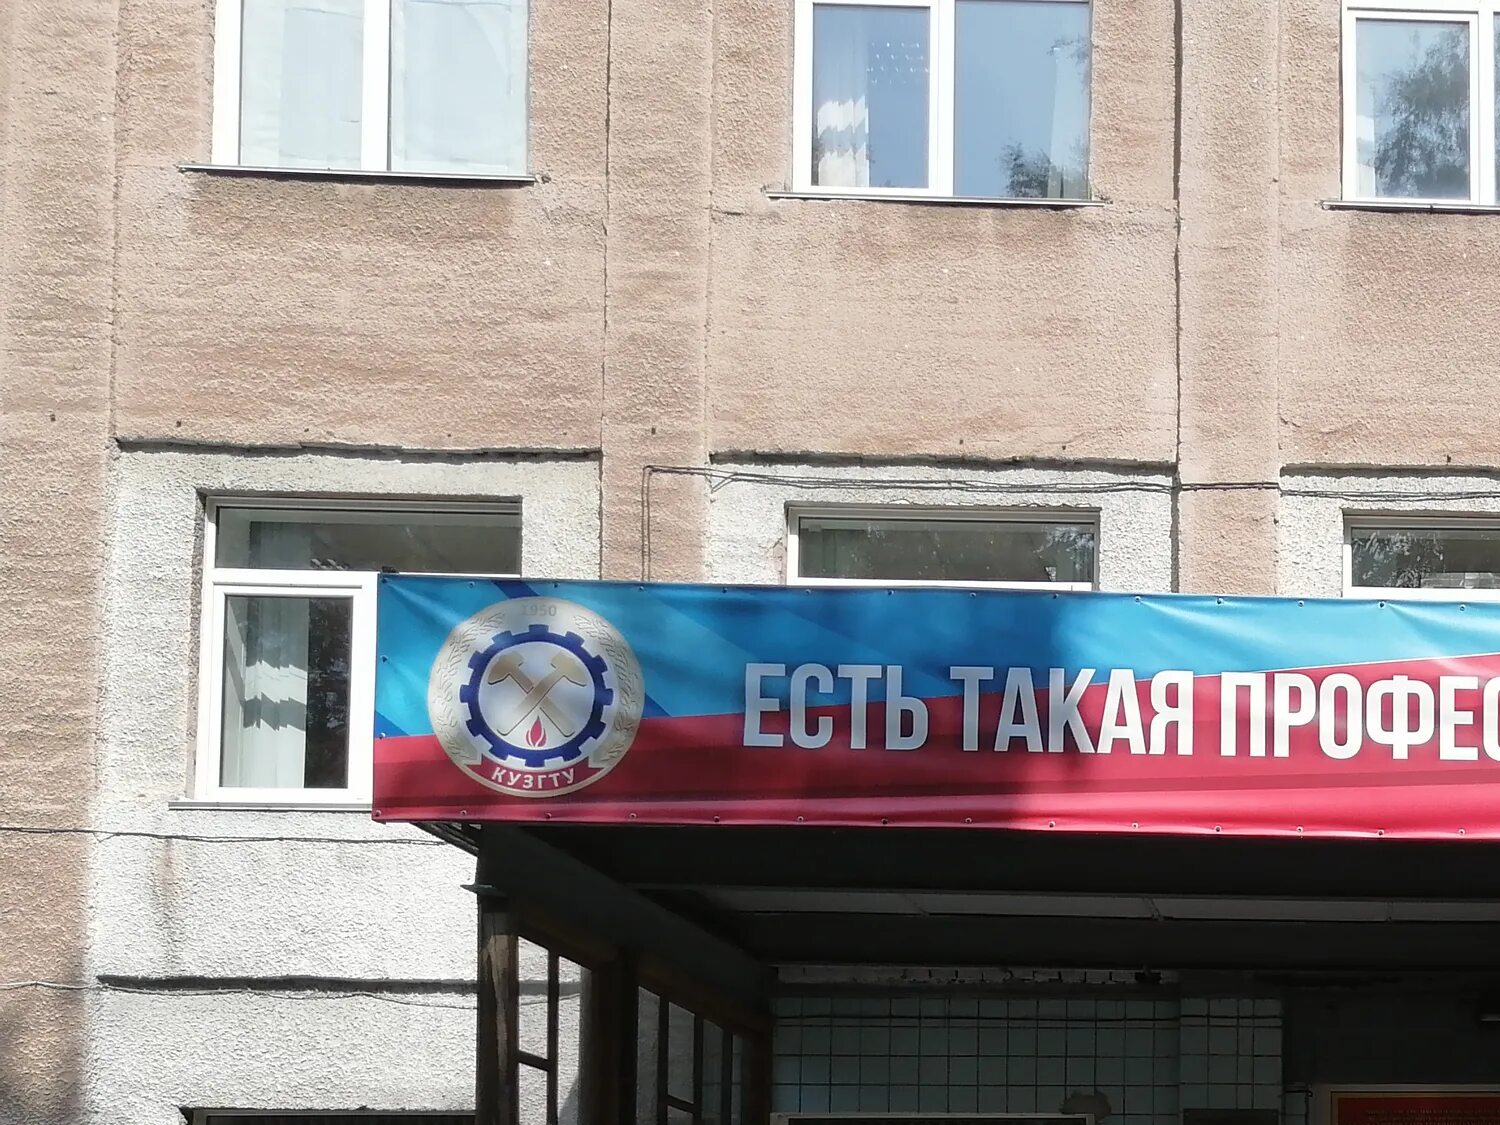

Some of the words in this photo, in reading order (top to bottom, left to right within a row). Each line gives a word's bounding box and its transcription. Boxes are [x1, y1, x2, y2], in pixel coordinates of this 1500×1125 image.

[520, 603, 558, 617] 1950
[743, 663, 929, 750] ЕСТЬ
[950, 666, 1194, 756] ТАКАЯ
[491, 767, 576, 789] КУЗГТУ
